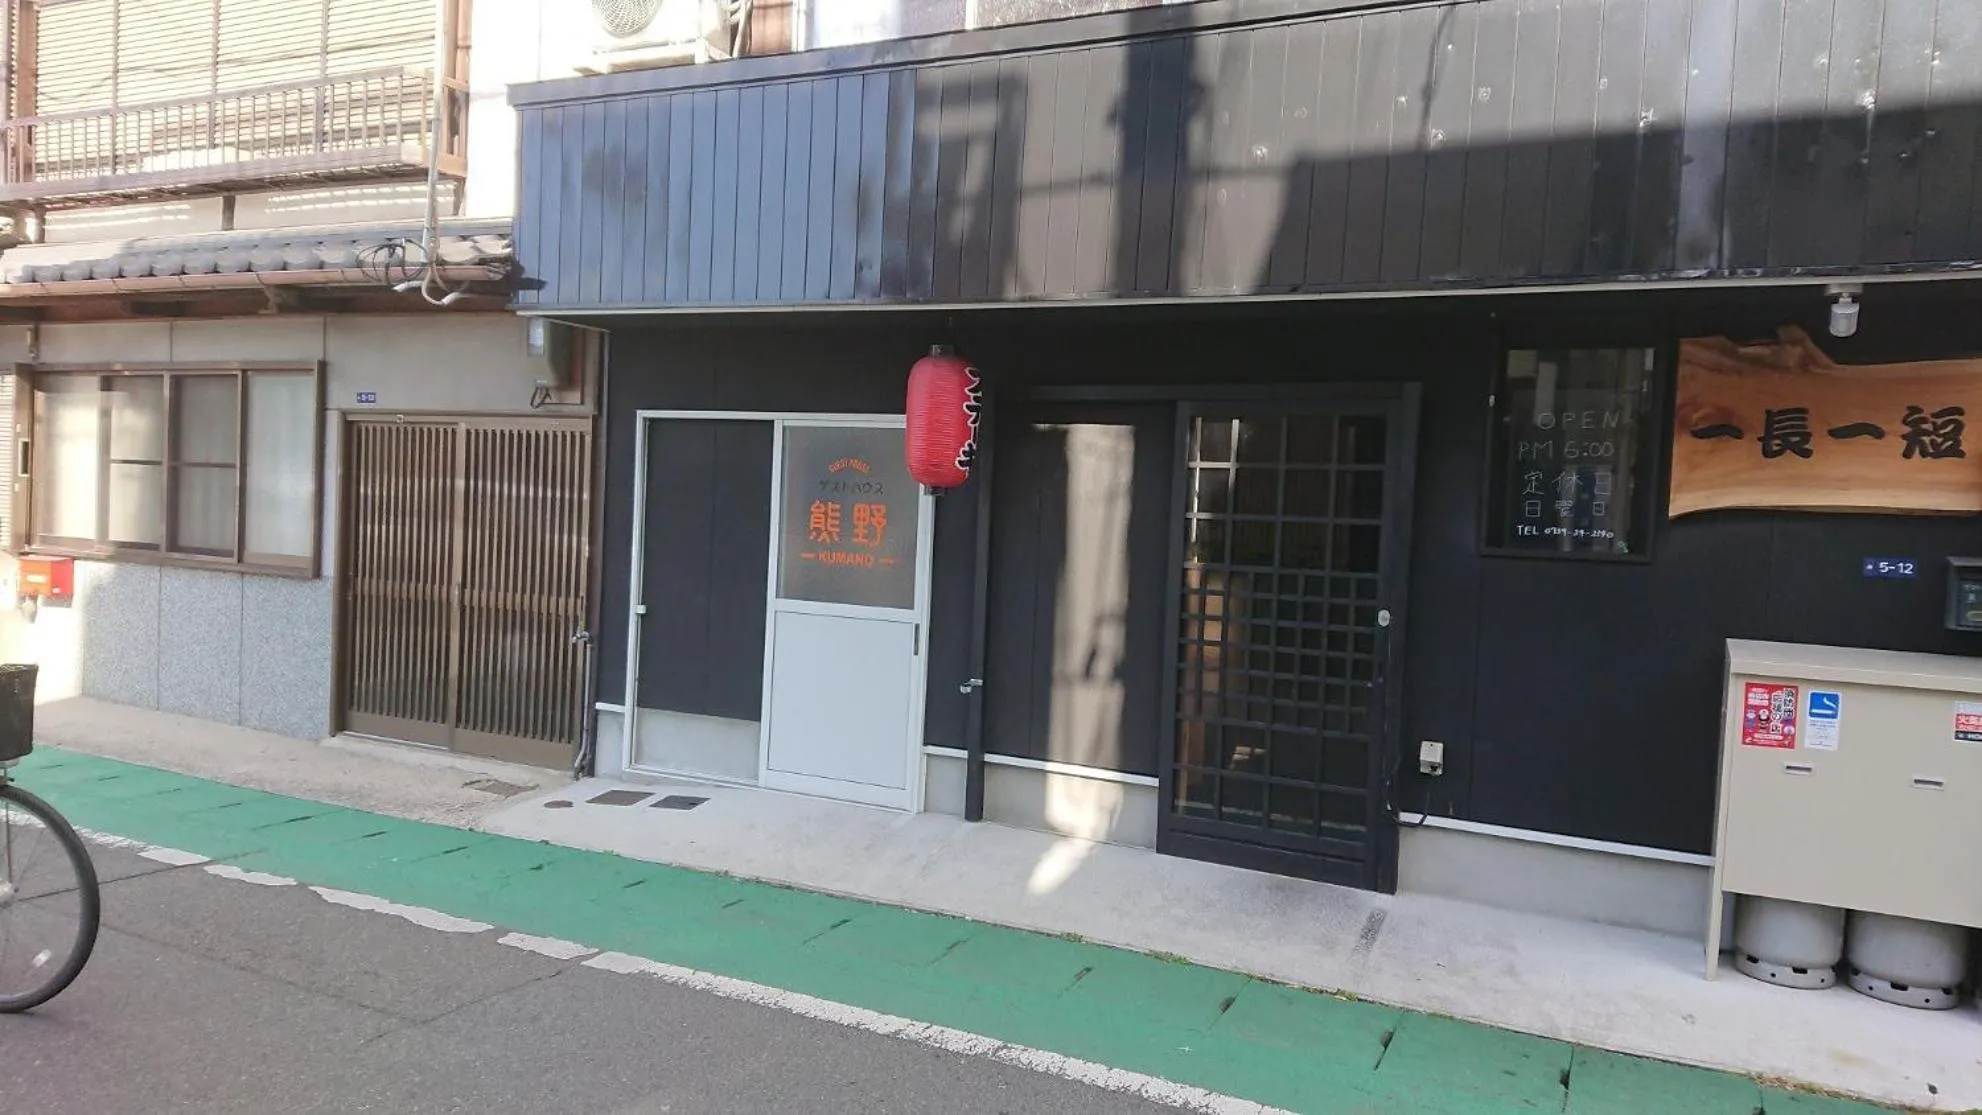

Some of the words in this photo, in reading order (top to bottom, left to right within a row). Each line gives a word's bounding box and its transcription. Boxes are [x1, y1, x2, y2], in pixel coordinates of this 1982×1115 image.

[1537, 410, 1620, 431] OPEN
[1690, 404, 1967, 460] 一長一短
[1518, 440, 1554, 461] PM
[1564, 439, 1615, 459] 6:00
[1521, 470, 1613, 497] 定休日
[808, 499, 888, 547] 熊野
[1516, 525, 1540, 537] TEL
[818, 549, 875, 568] KUMANO
[1879, 561, 1914, 574] 5-12
